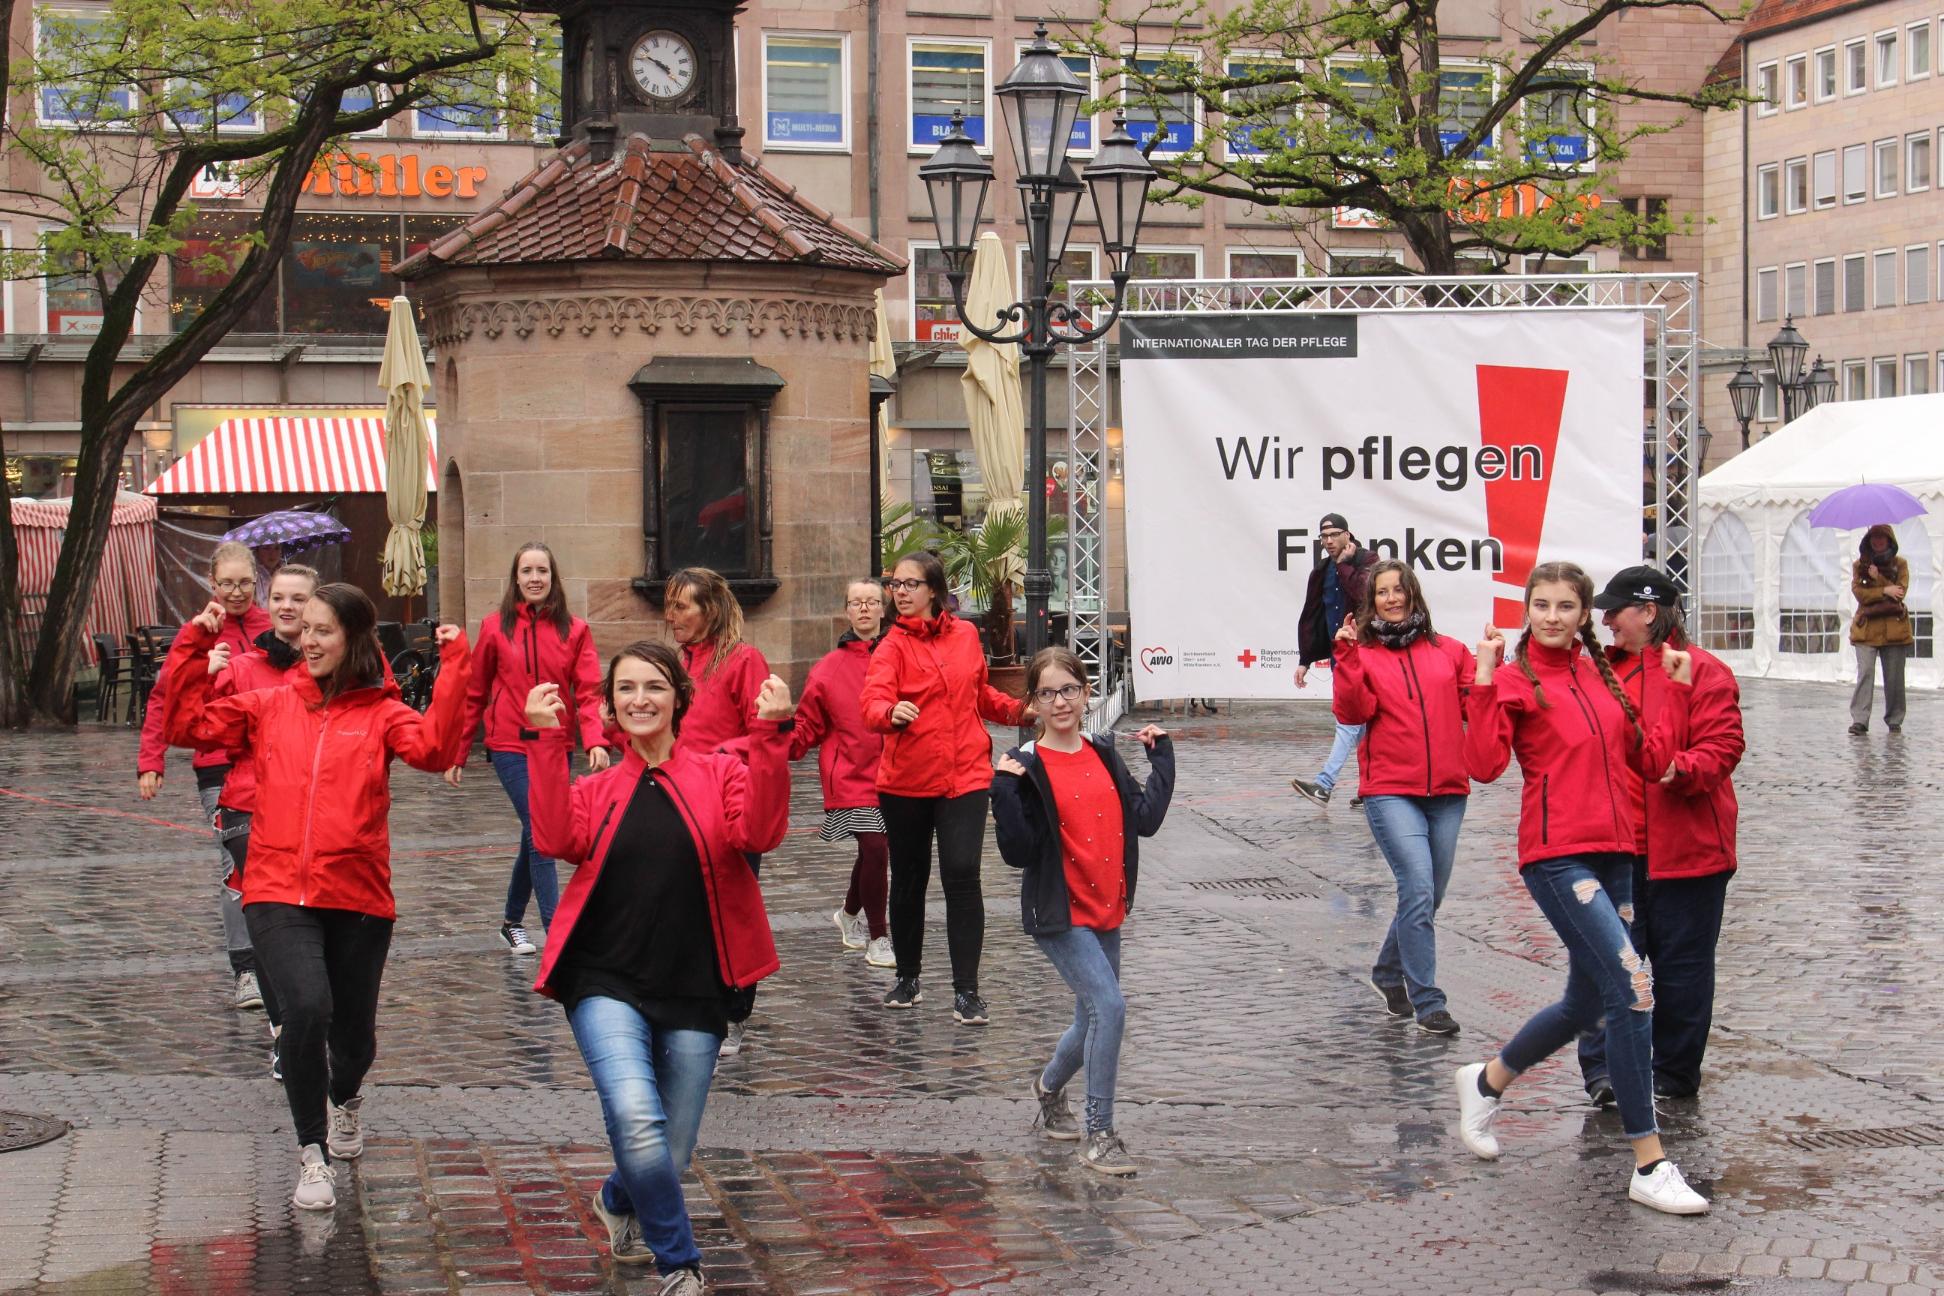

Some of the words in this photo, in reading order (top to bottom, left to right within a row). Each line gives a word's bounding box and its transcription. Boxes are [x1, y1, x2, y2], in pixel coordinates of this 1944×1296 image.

[1132, 337, 1242, 349] INTERNATIONALER
[1245, 337, 1269, 348] TAG
[1272, 337, 1297, 348] DER
[1300, 337, 1347, 348] PFLEGE
[1215, 436, 1304, 480] Wir
[1322, 435, 1543, 492] pflegen
[1277, 527, 1504, 572] Frnken
[1260, 648, 1300, 657] Bayerische
[1149, 655, 1173, 666] AWO
